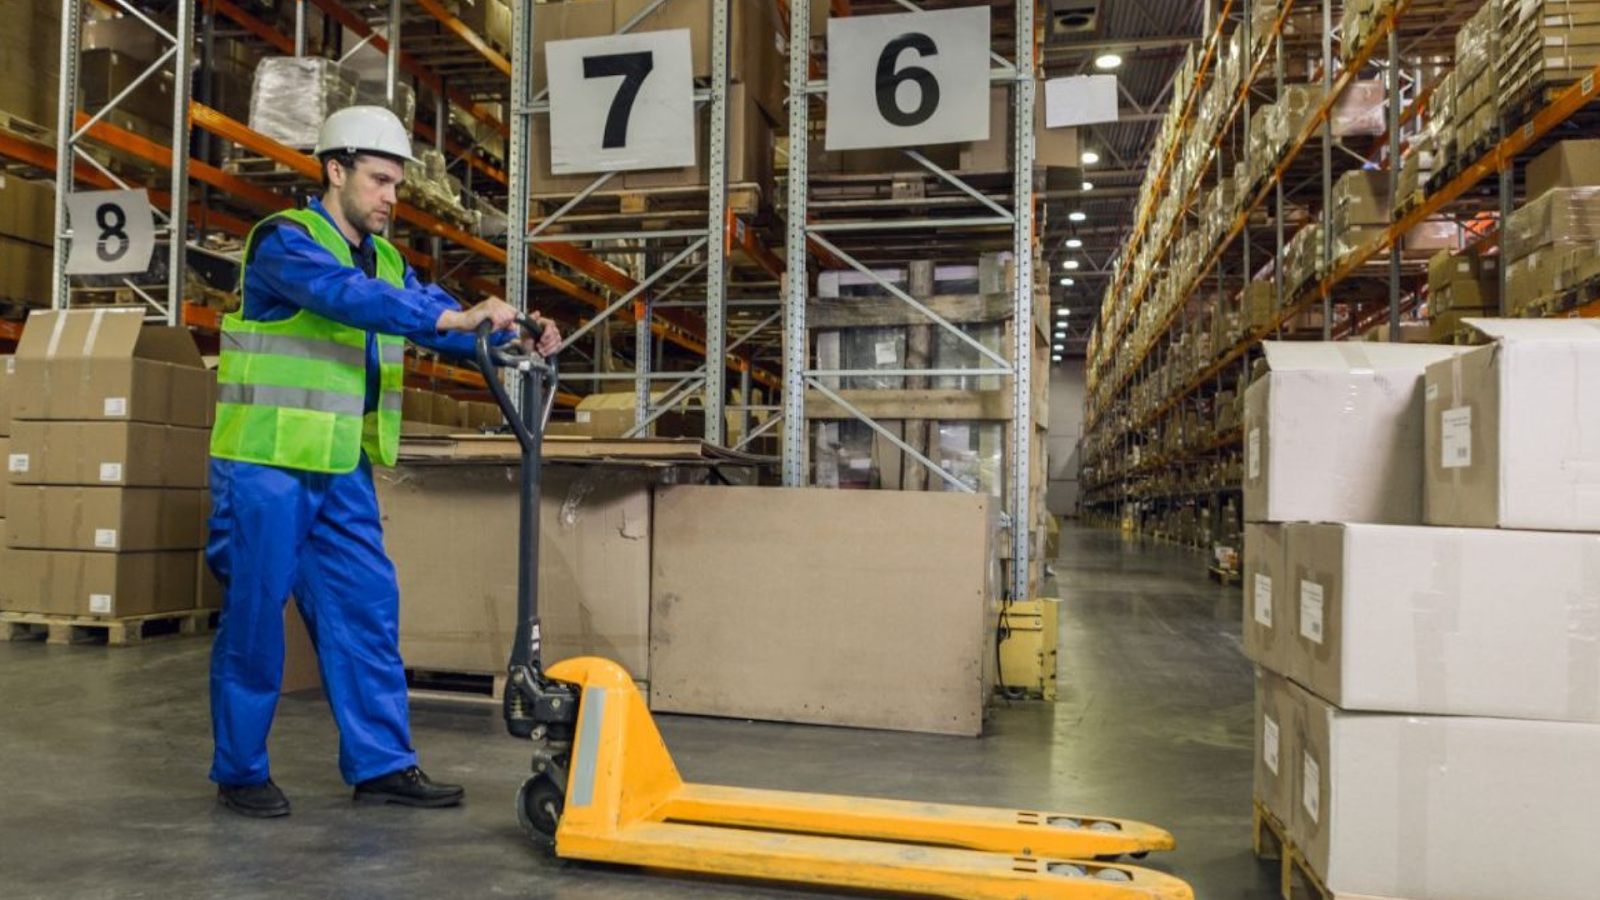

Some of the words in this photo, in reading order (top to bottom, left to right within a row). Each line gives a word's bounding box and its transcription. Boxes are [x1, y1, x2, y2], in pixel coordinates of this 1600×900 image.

[582, 50, 654, 150] 7
[874, 32, 940, 127] 6
[96, 202, 130, 262] 8
